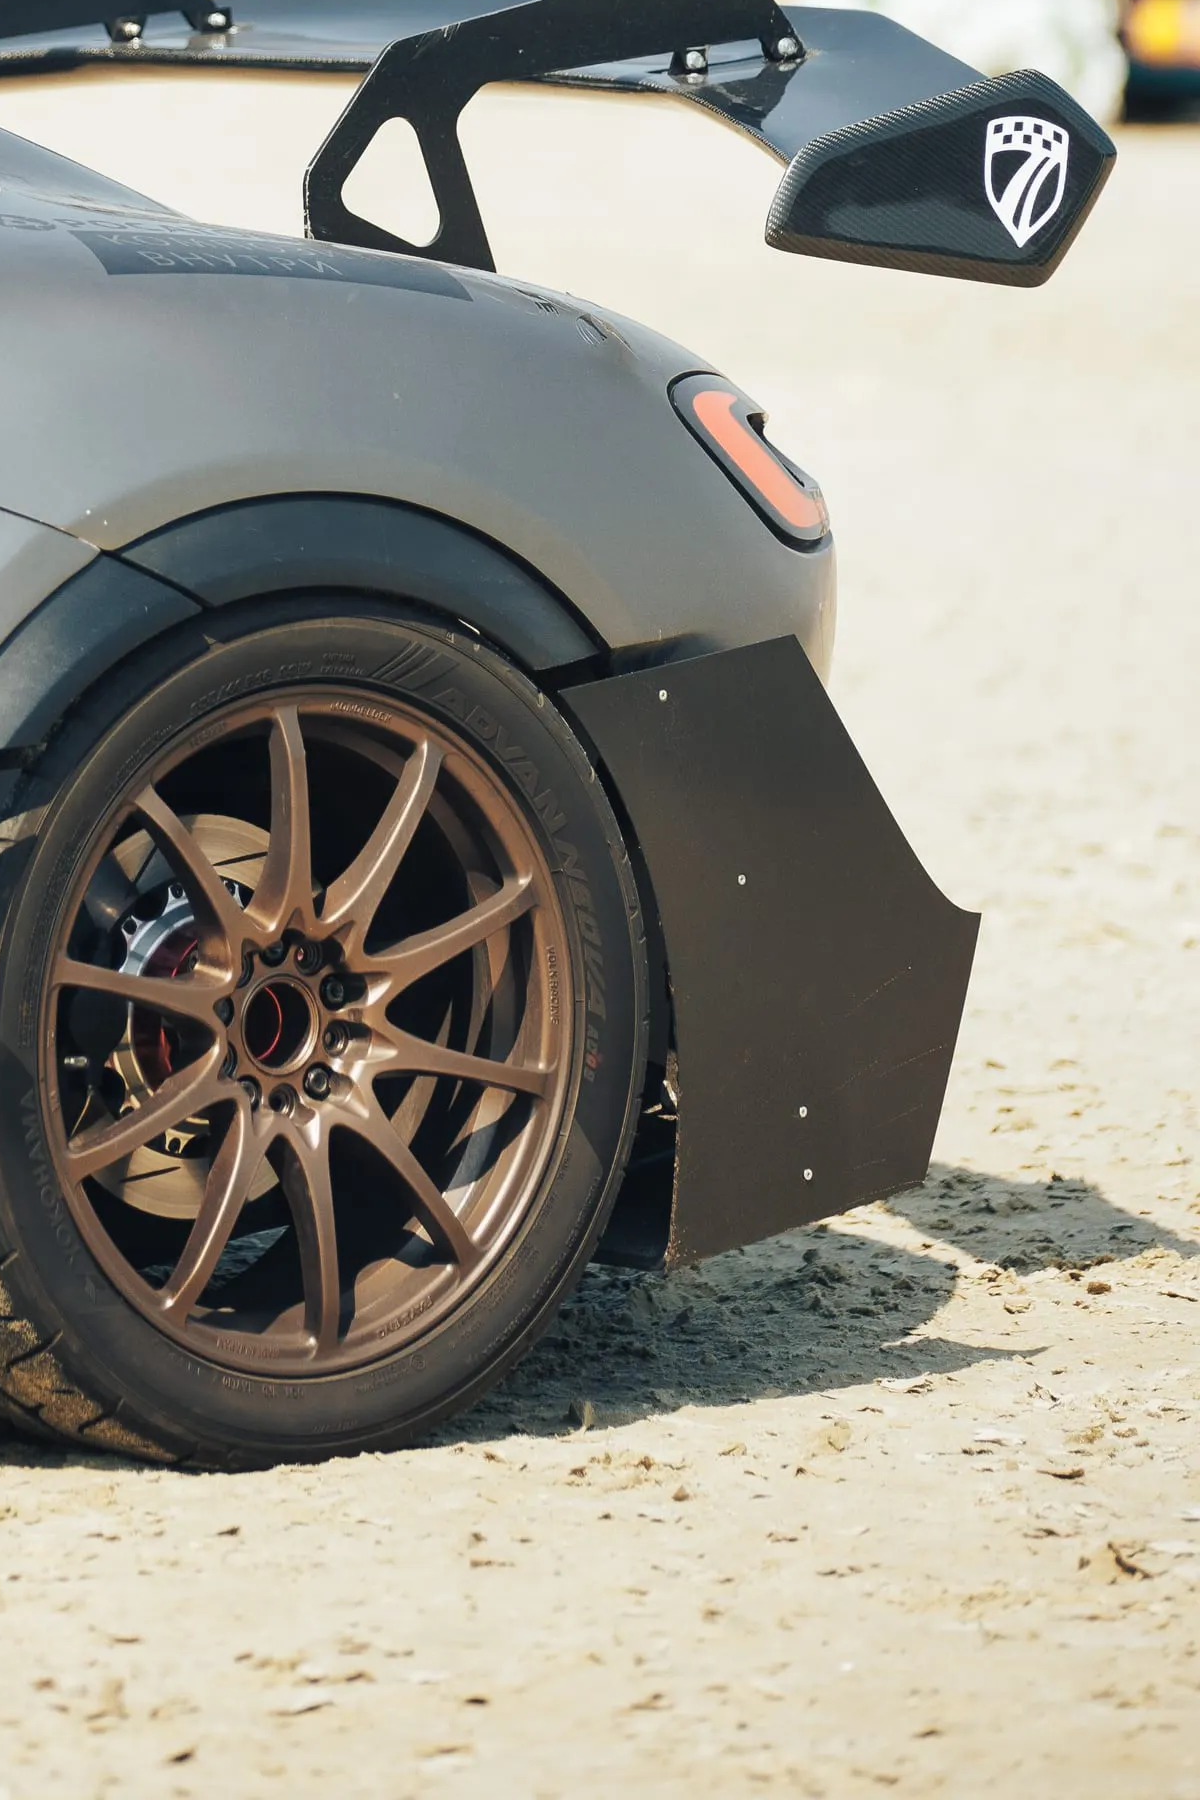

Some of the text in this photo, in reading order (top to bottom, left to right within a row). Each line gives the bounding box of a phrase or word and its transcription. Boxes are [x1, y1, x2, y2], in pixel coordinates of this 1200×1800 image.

[137, 250, 344, 276] ВНУТРИ
[429, 686, 569, 837] ADVAN
[550, 836, 608, 1023] NEOVA
[19, 1087, 82, 1268] YOKOHAMA
